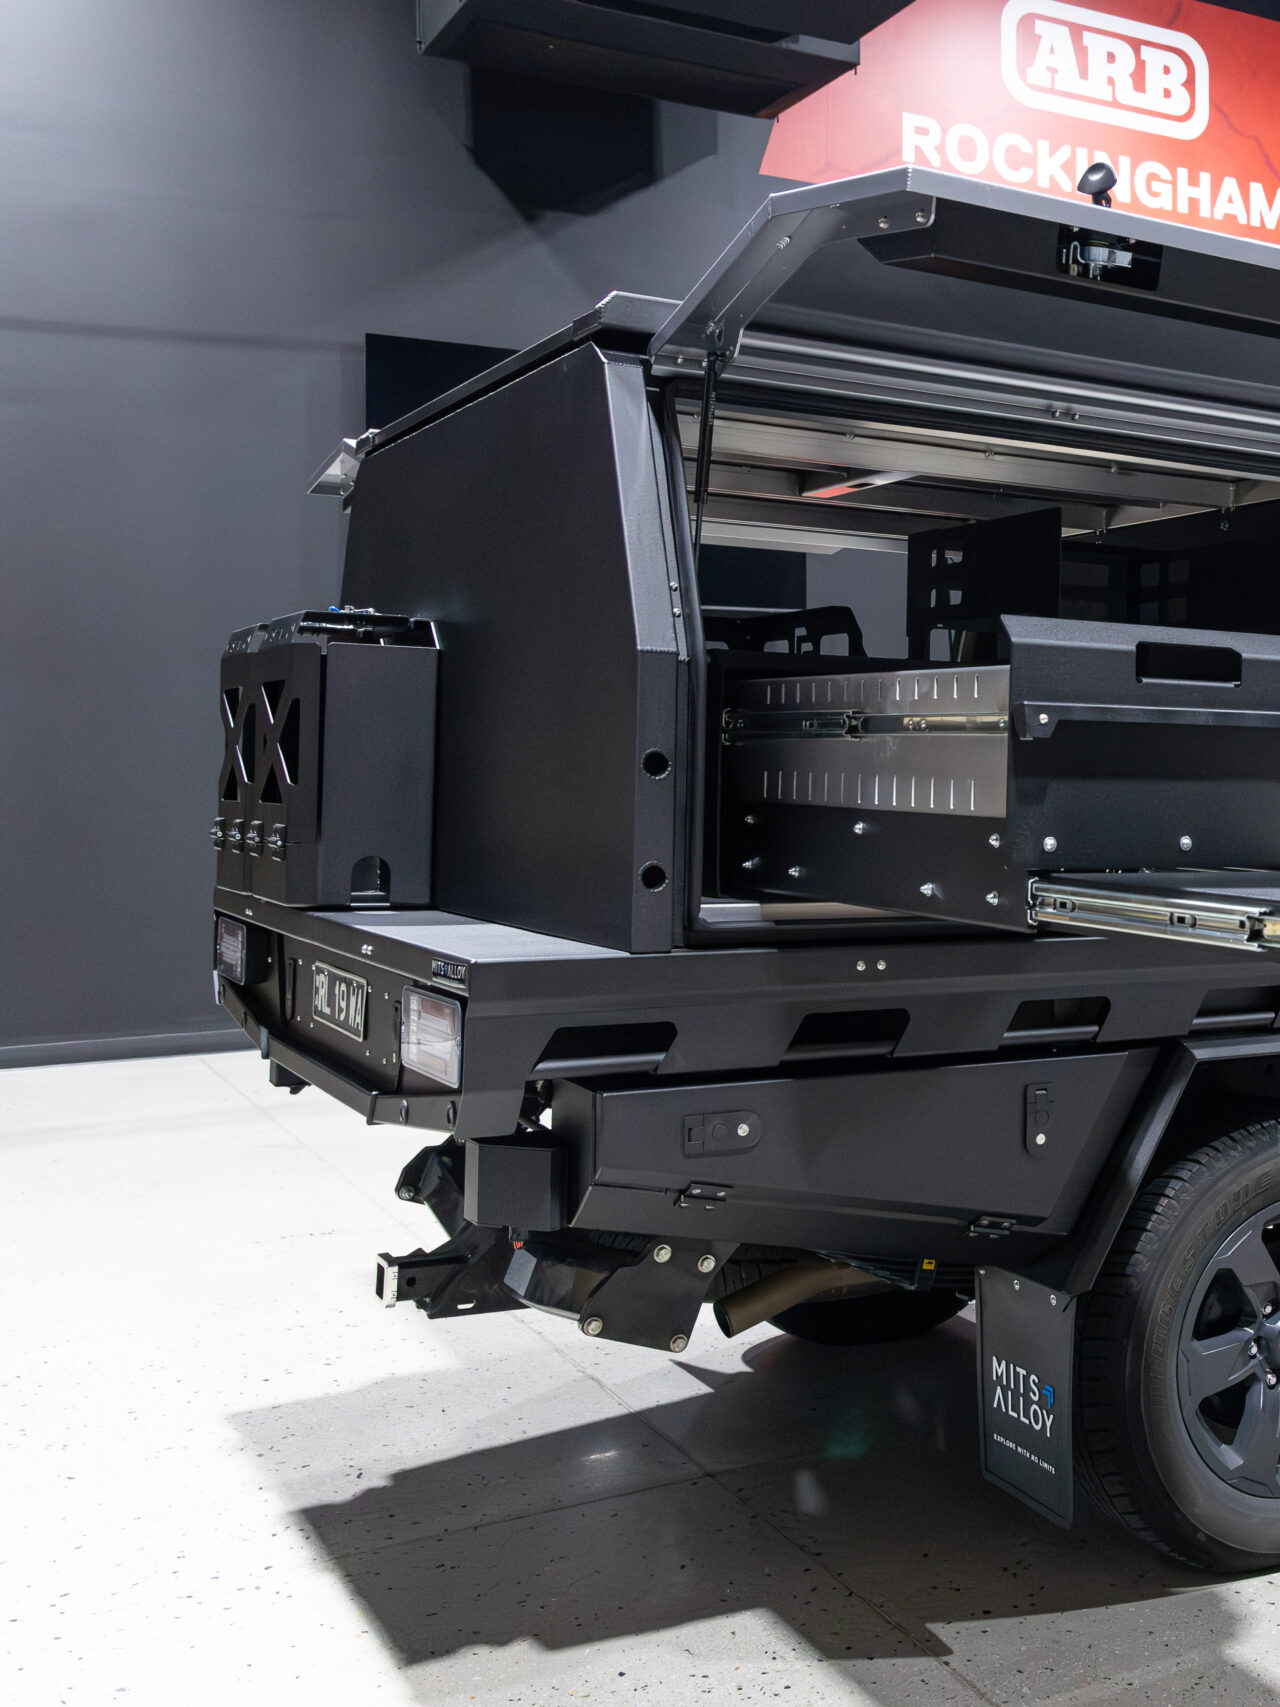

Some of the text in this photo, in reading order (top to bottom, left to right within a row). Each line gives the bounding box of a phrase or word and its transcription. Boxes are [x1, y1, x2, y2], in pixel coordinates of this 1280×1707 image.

[1026, 19, 1191, 117] ARB
[335, 980, 347, 1021] 19
[349, 985, 362, 1030] WA
[992, 1355, 1040, 1402] MITS
[993, 1385, 1054, 1438] ALLOY
[993, 1433, 1055, 1474] EXPLORE WITH NO LIMITS
